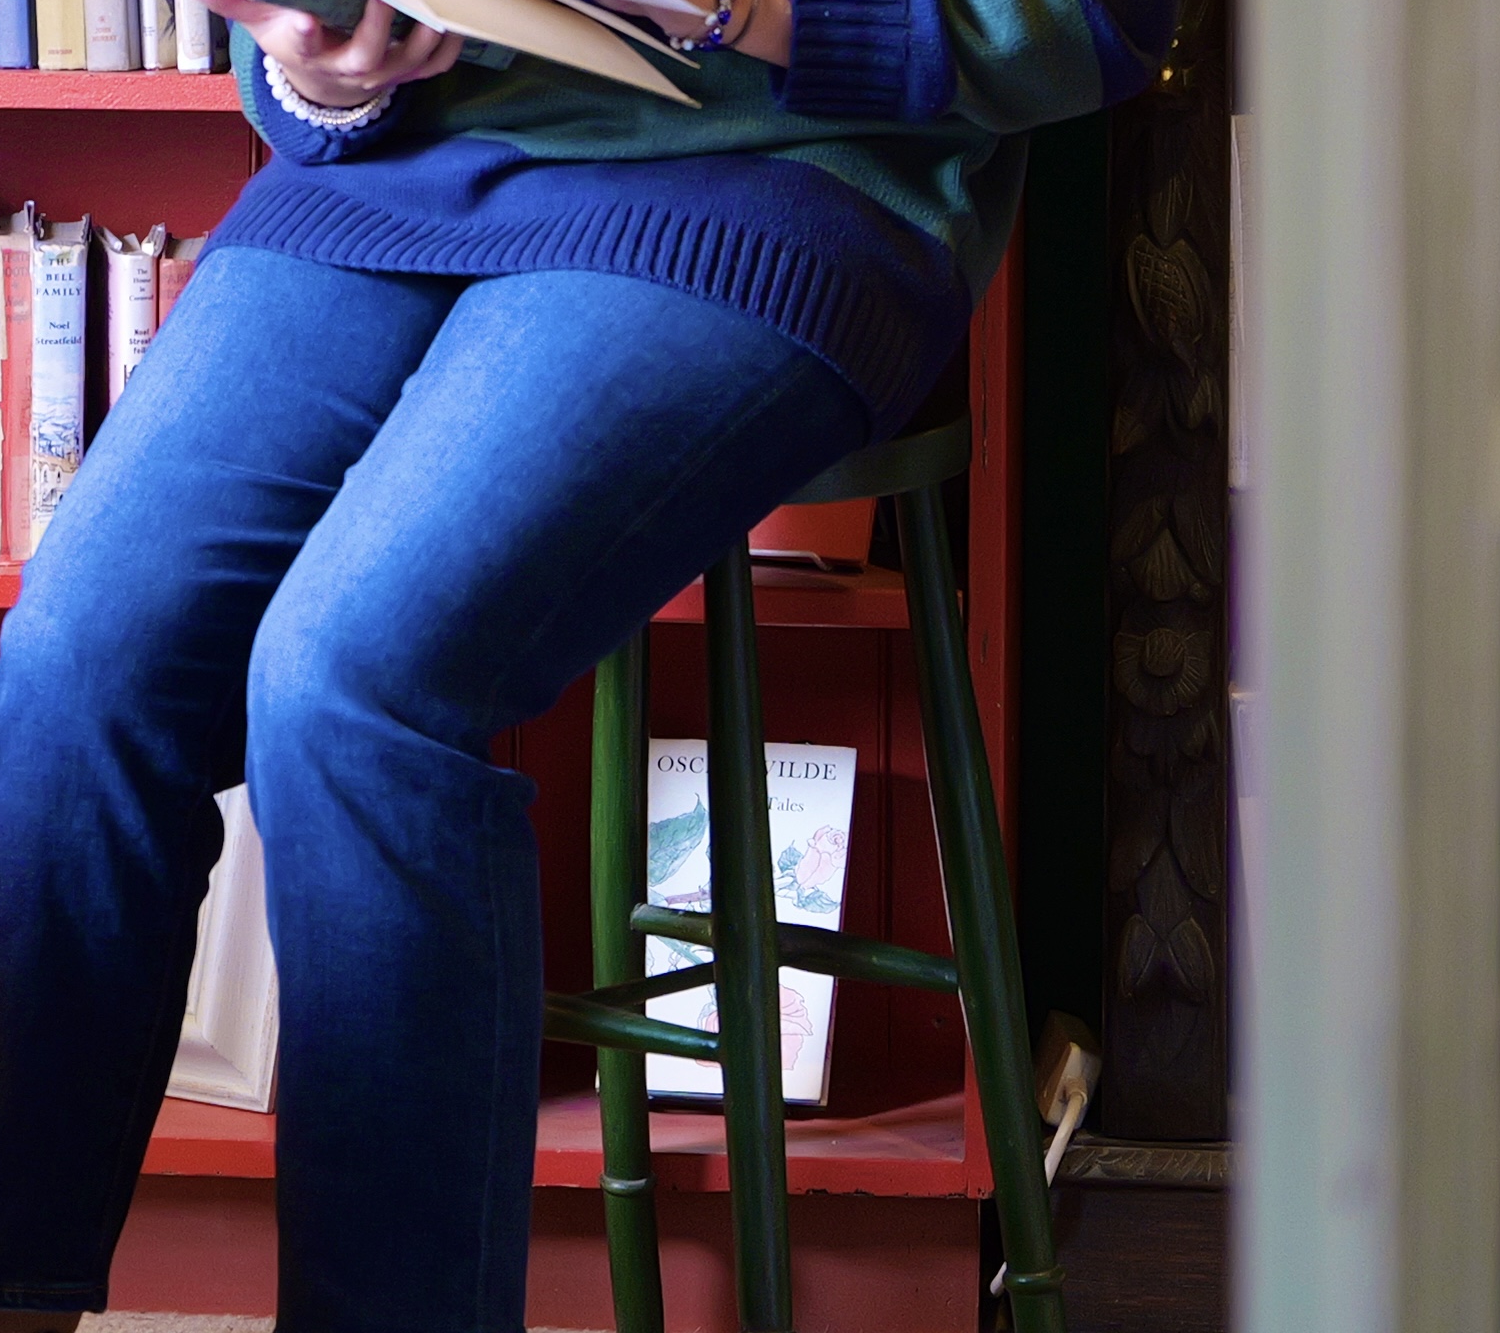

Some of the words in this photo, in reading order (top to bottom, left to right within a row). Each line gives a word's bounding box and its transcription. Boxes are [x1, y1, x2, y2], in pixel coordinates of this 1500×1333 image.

[45, 273, 75, 281] BELL
[35, 288, 82, 296] FAMILY
[48, 321, 70, 330] Noel
[36, 336, 82, 345] Streatfeild
[767, 796, 805, 813] Tales
